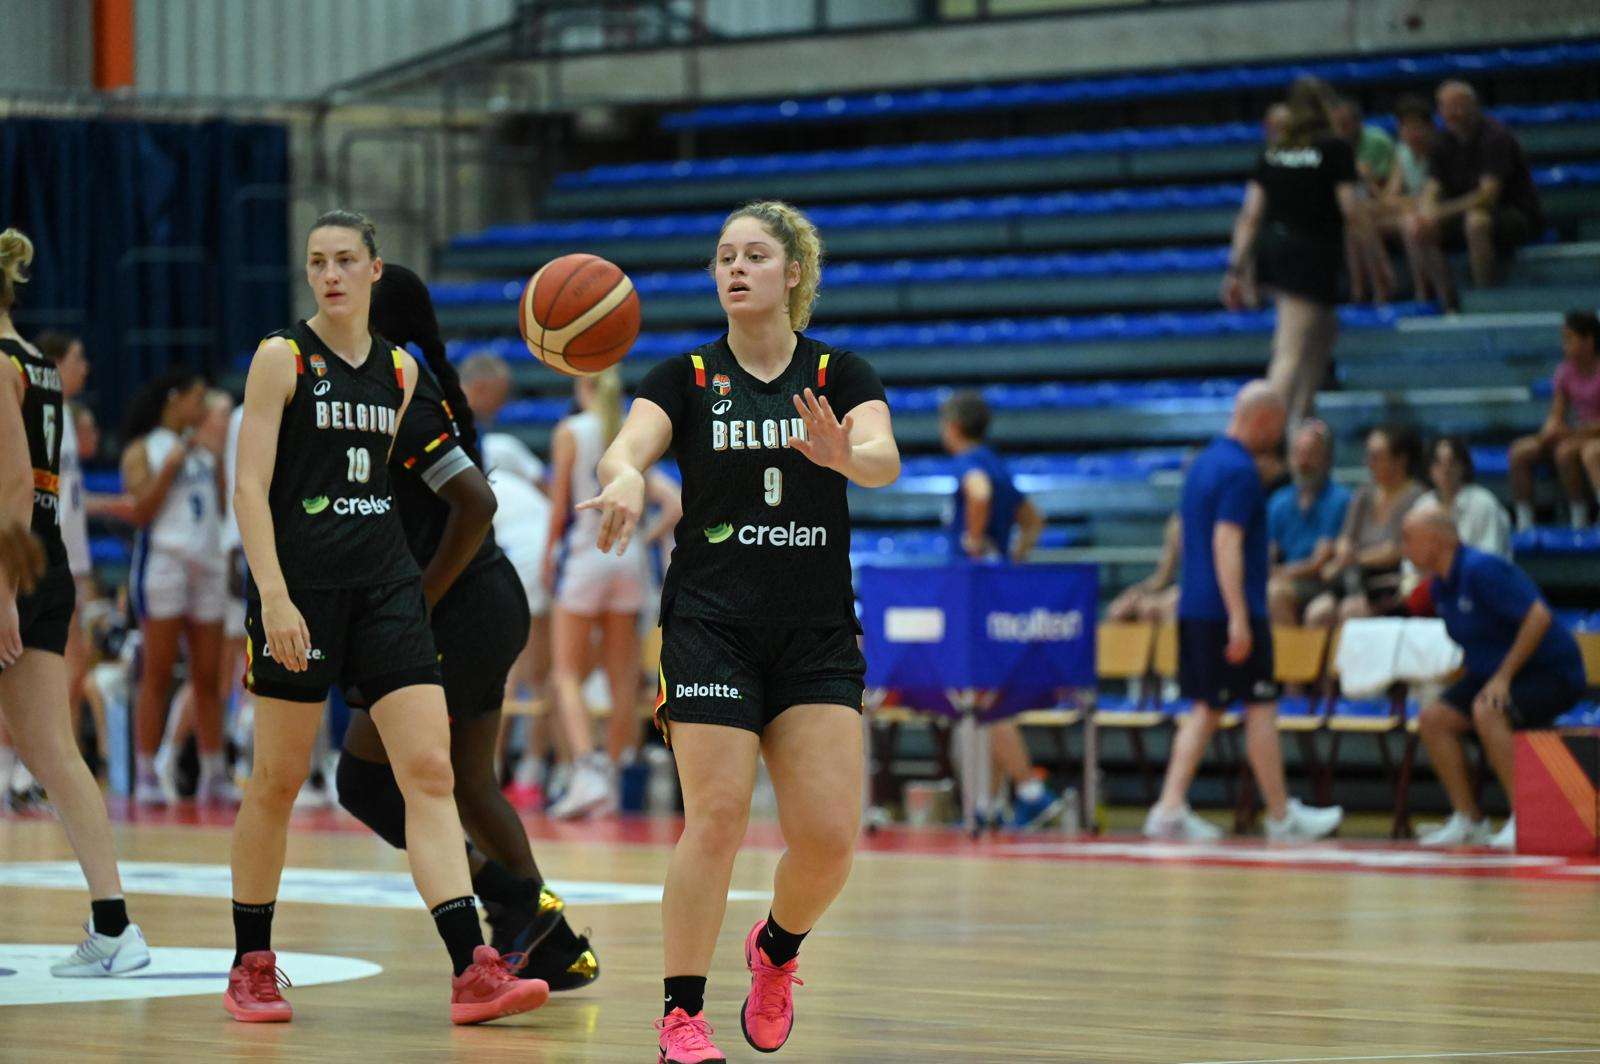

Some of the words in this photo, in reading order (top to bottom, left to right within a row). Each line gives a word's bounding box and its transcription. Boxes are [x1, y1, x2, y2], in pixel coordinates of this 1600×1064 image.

[712, 418, 808, 451] BELGIU
[347, 447, 371, 483] 10
[763, 467, 783, 507] 9
[738, 521, 827, 547] crelan
